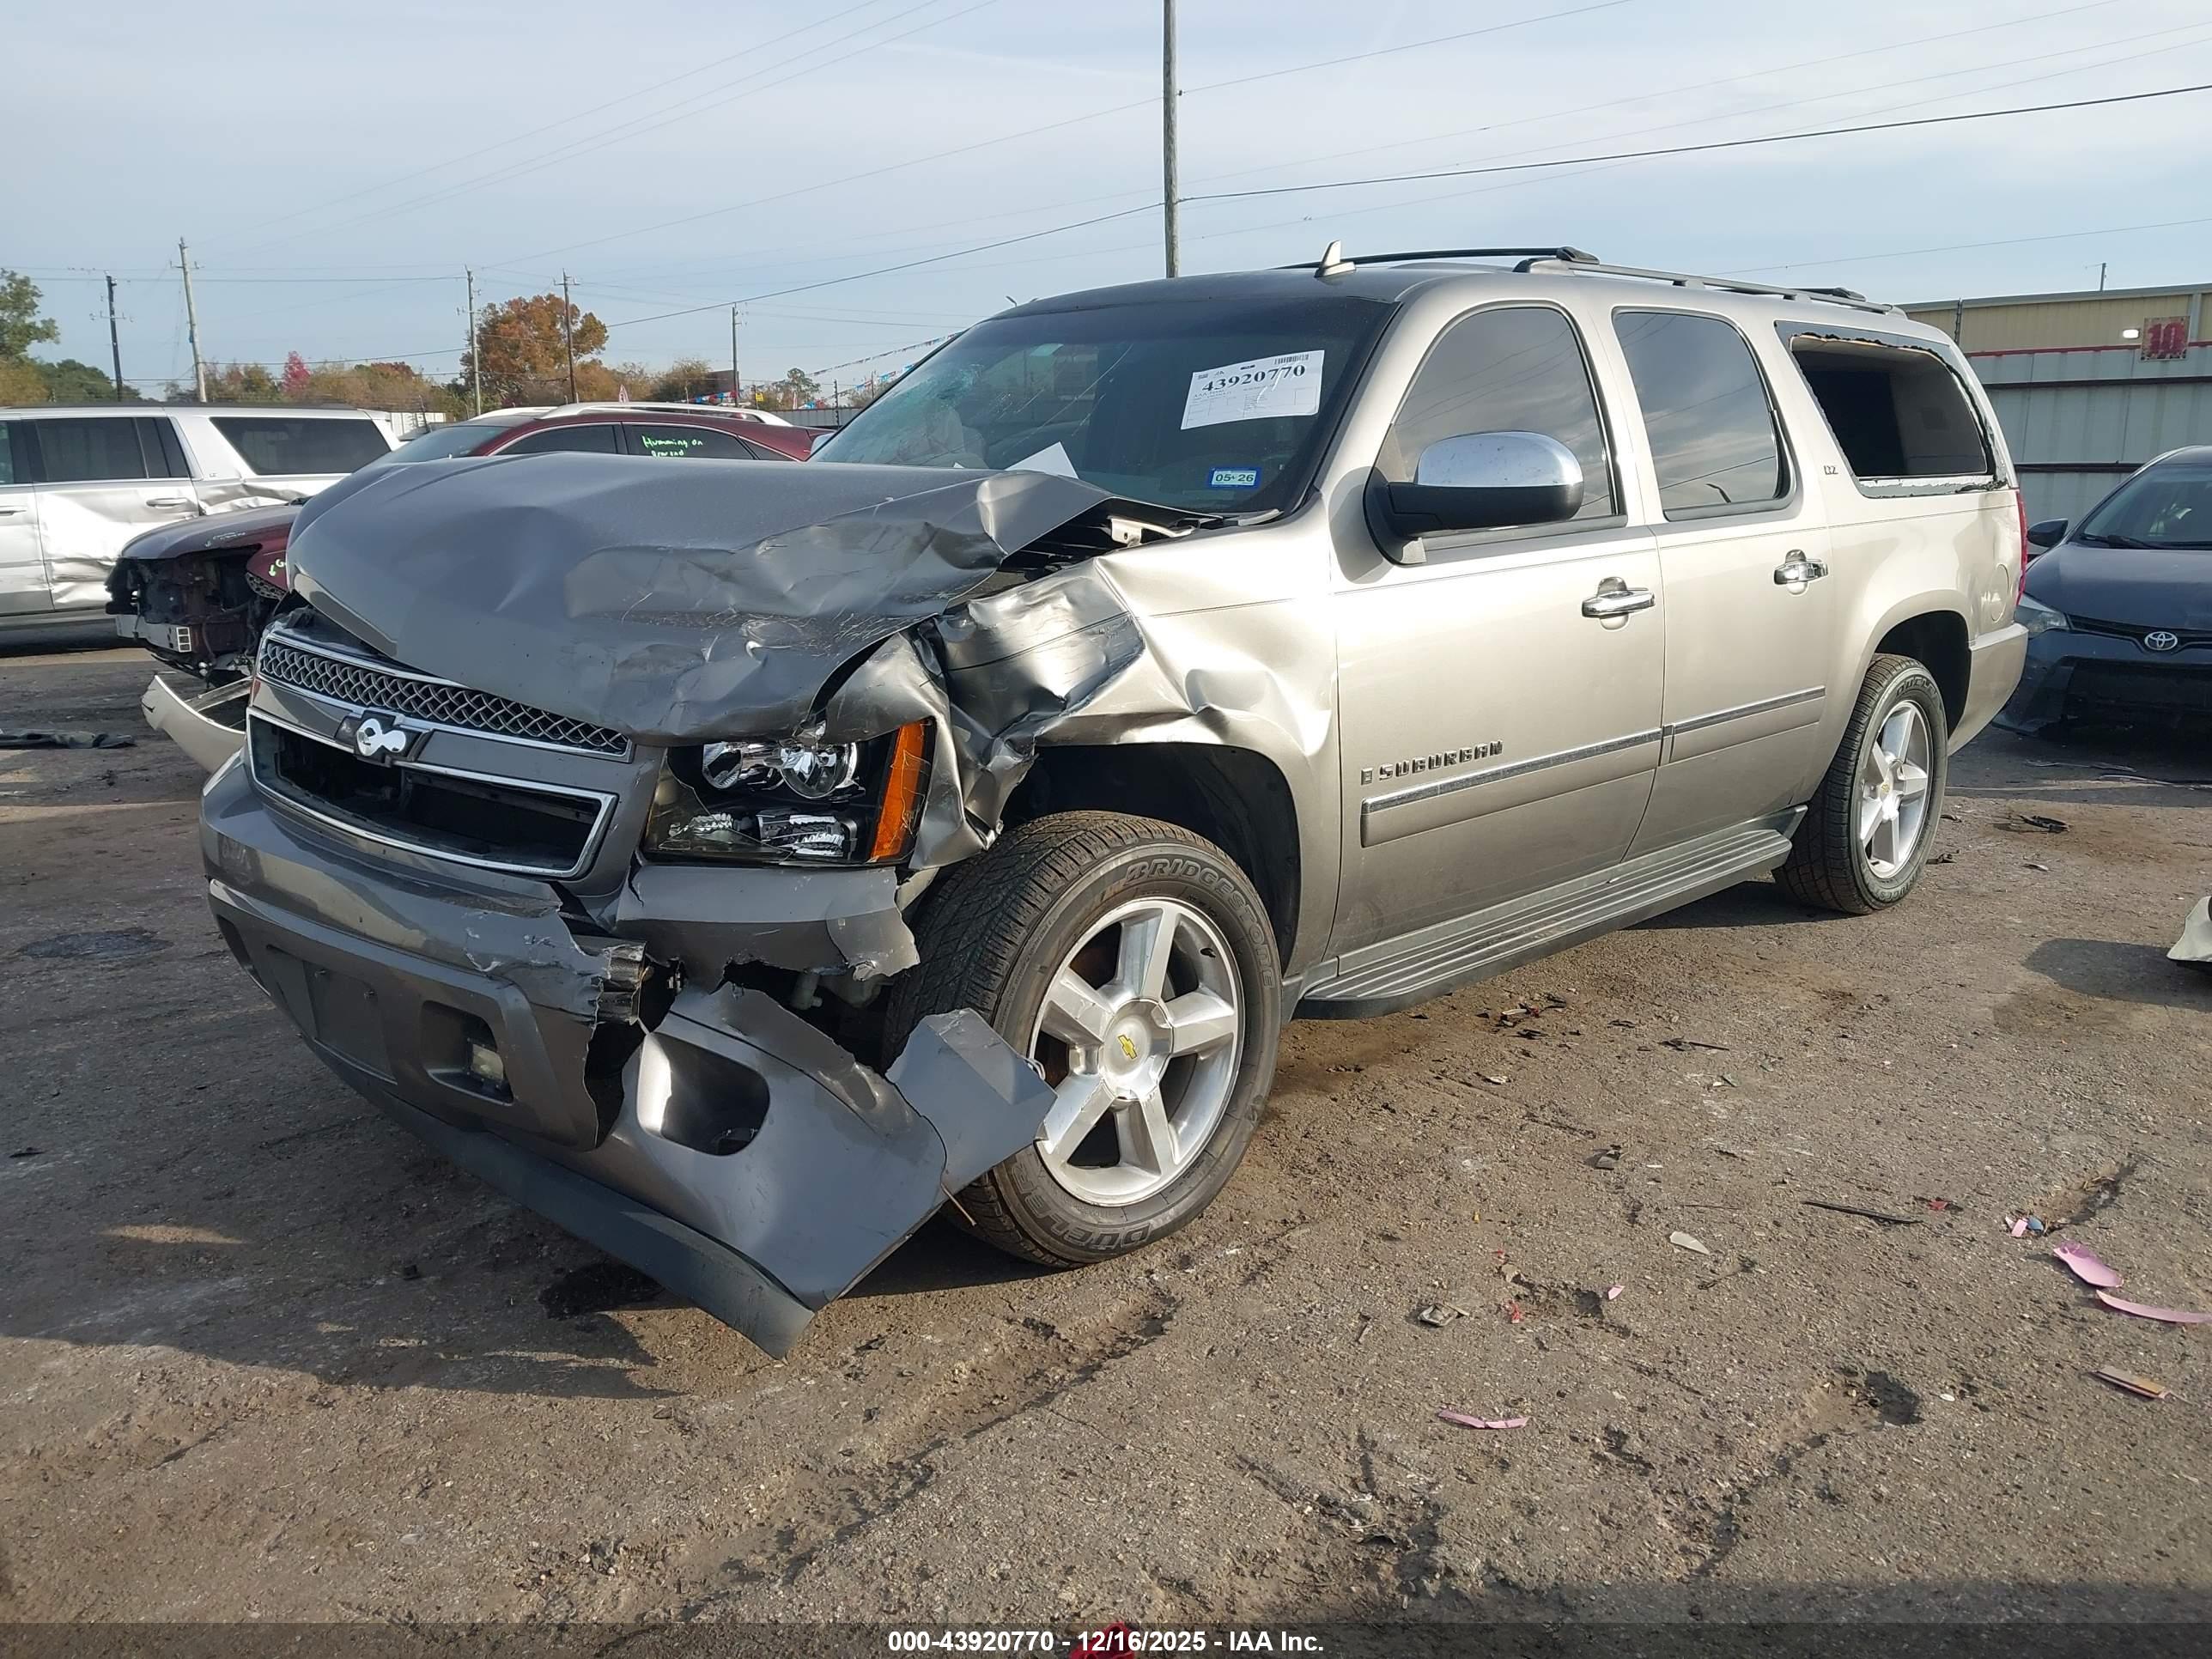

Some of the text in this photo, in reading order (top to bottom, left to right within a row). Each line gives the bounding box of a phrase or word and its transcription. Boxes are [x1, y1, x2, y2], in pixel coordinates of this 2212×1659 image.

[1201, 364, 1306, 392] 43920770
[1378, 740, 1504, 781] SUBURBAN
[1123, 858, 1275, 988] BRIDGESTONE
[1011, 1162, 1152, 1250] DUELER
